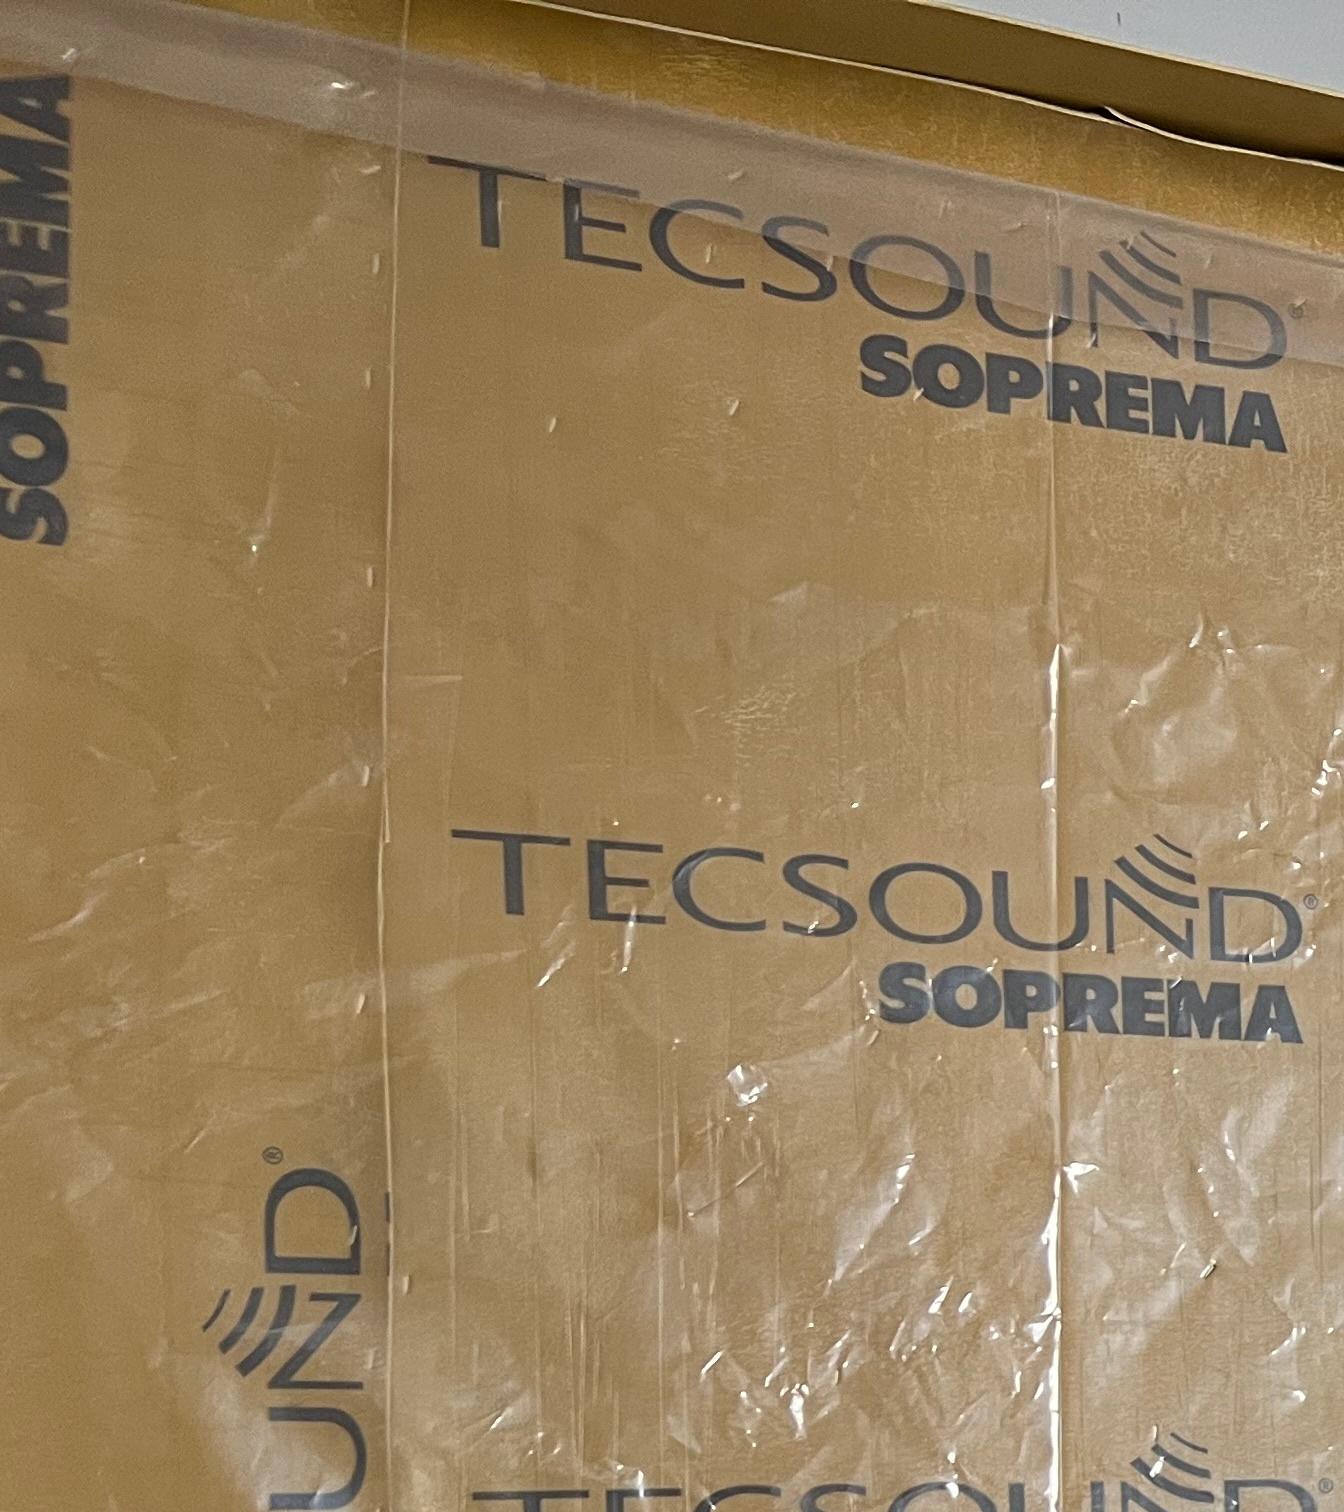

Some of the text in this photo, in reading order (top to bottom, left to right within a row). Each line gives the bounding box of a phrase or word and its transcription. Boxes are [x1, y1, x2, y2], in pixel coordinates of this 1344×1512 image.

[428, 156, 1288, 370] TECSOUND
[859, 334, 1288, 452] SOPREMA
[451, 829, 1303, 963] TECSOUND
[877, 961, 1303, 1044] SOPREMA
